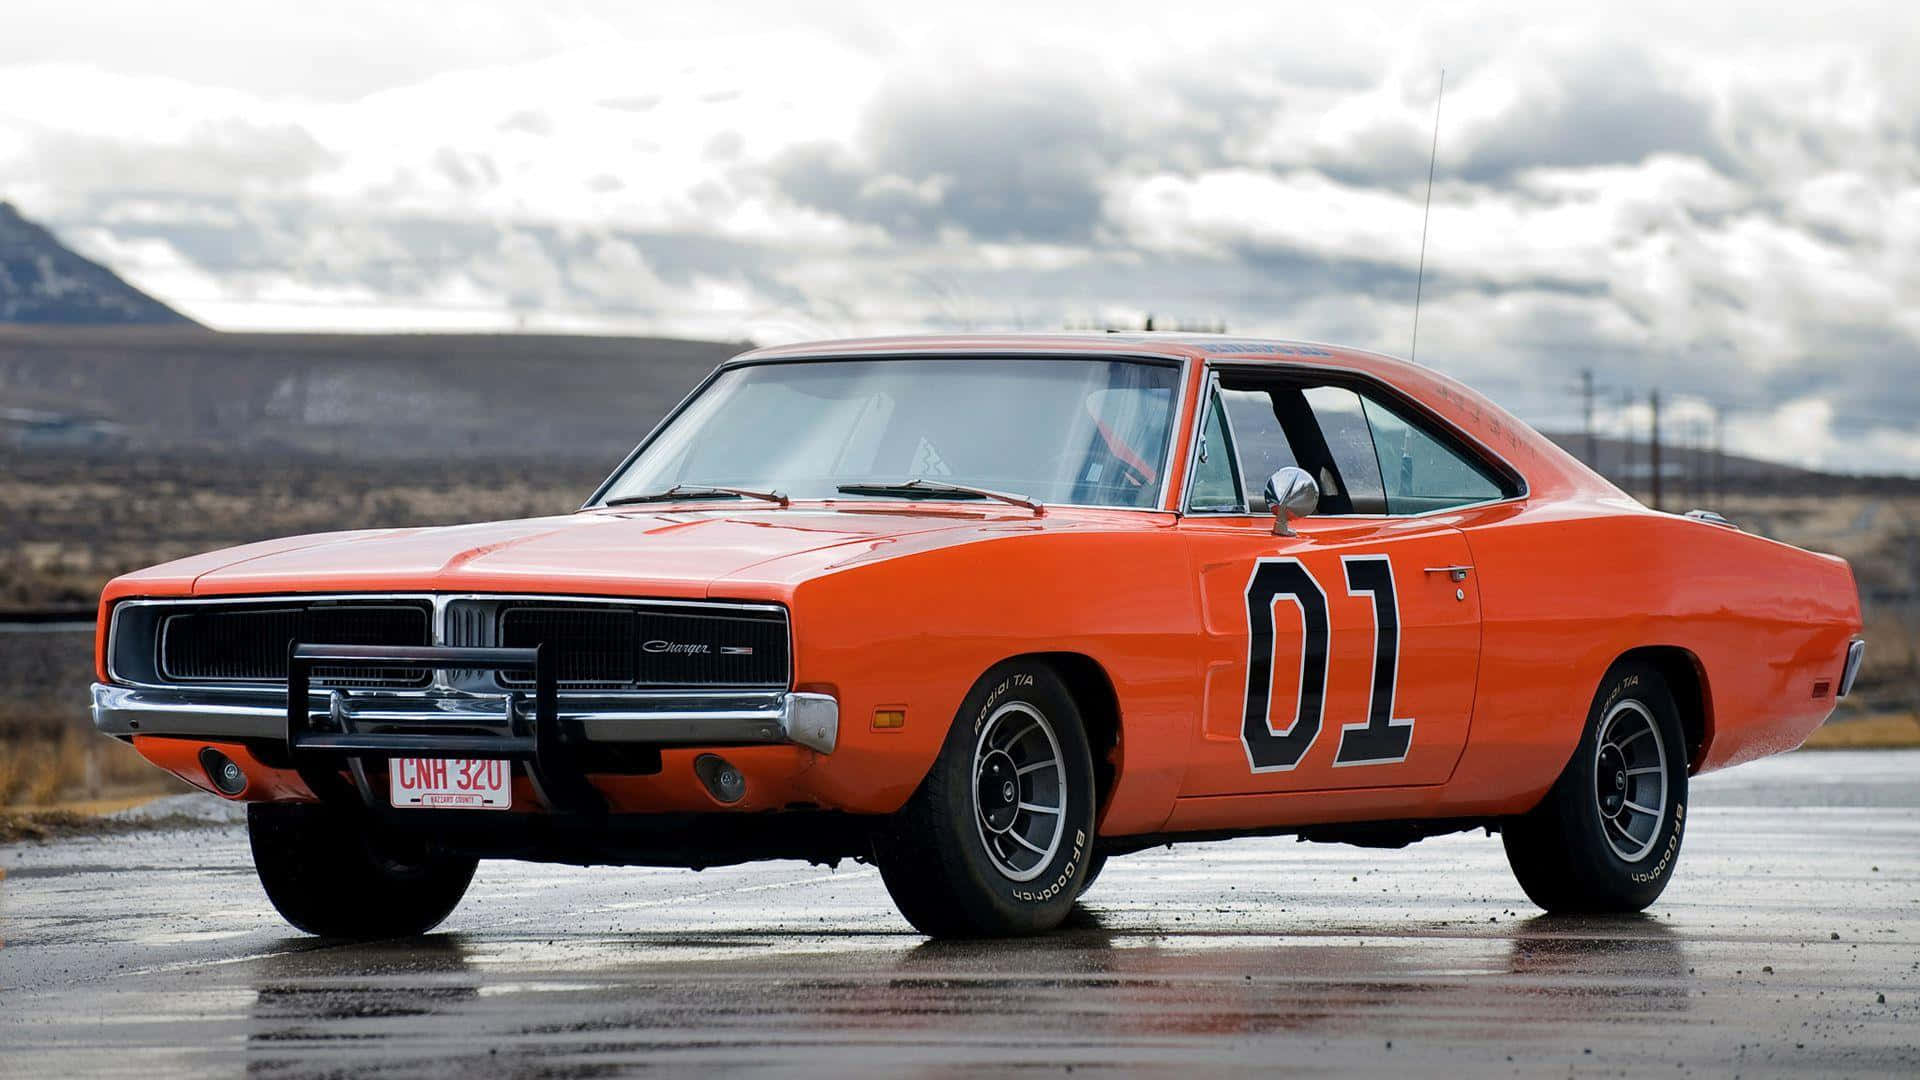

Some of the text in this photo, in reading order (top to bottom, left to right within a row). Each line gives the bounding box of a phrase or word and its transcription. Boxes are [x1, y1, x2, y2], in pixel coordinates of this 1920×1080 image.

[642, 640, 711, 657] Charger
[1240, 553, 1415, 774] 01
[974, 674, 1033, 736] Radial T/A
[1623, 675, 1639, 688] T/A
[399, 758, 502, 791] CNH 320
[1012, 829, 1085, 902] BFGoodrich
[1631, 803, 1683, 883] BFGoodrich
